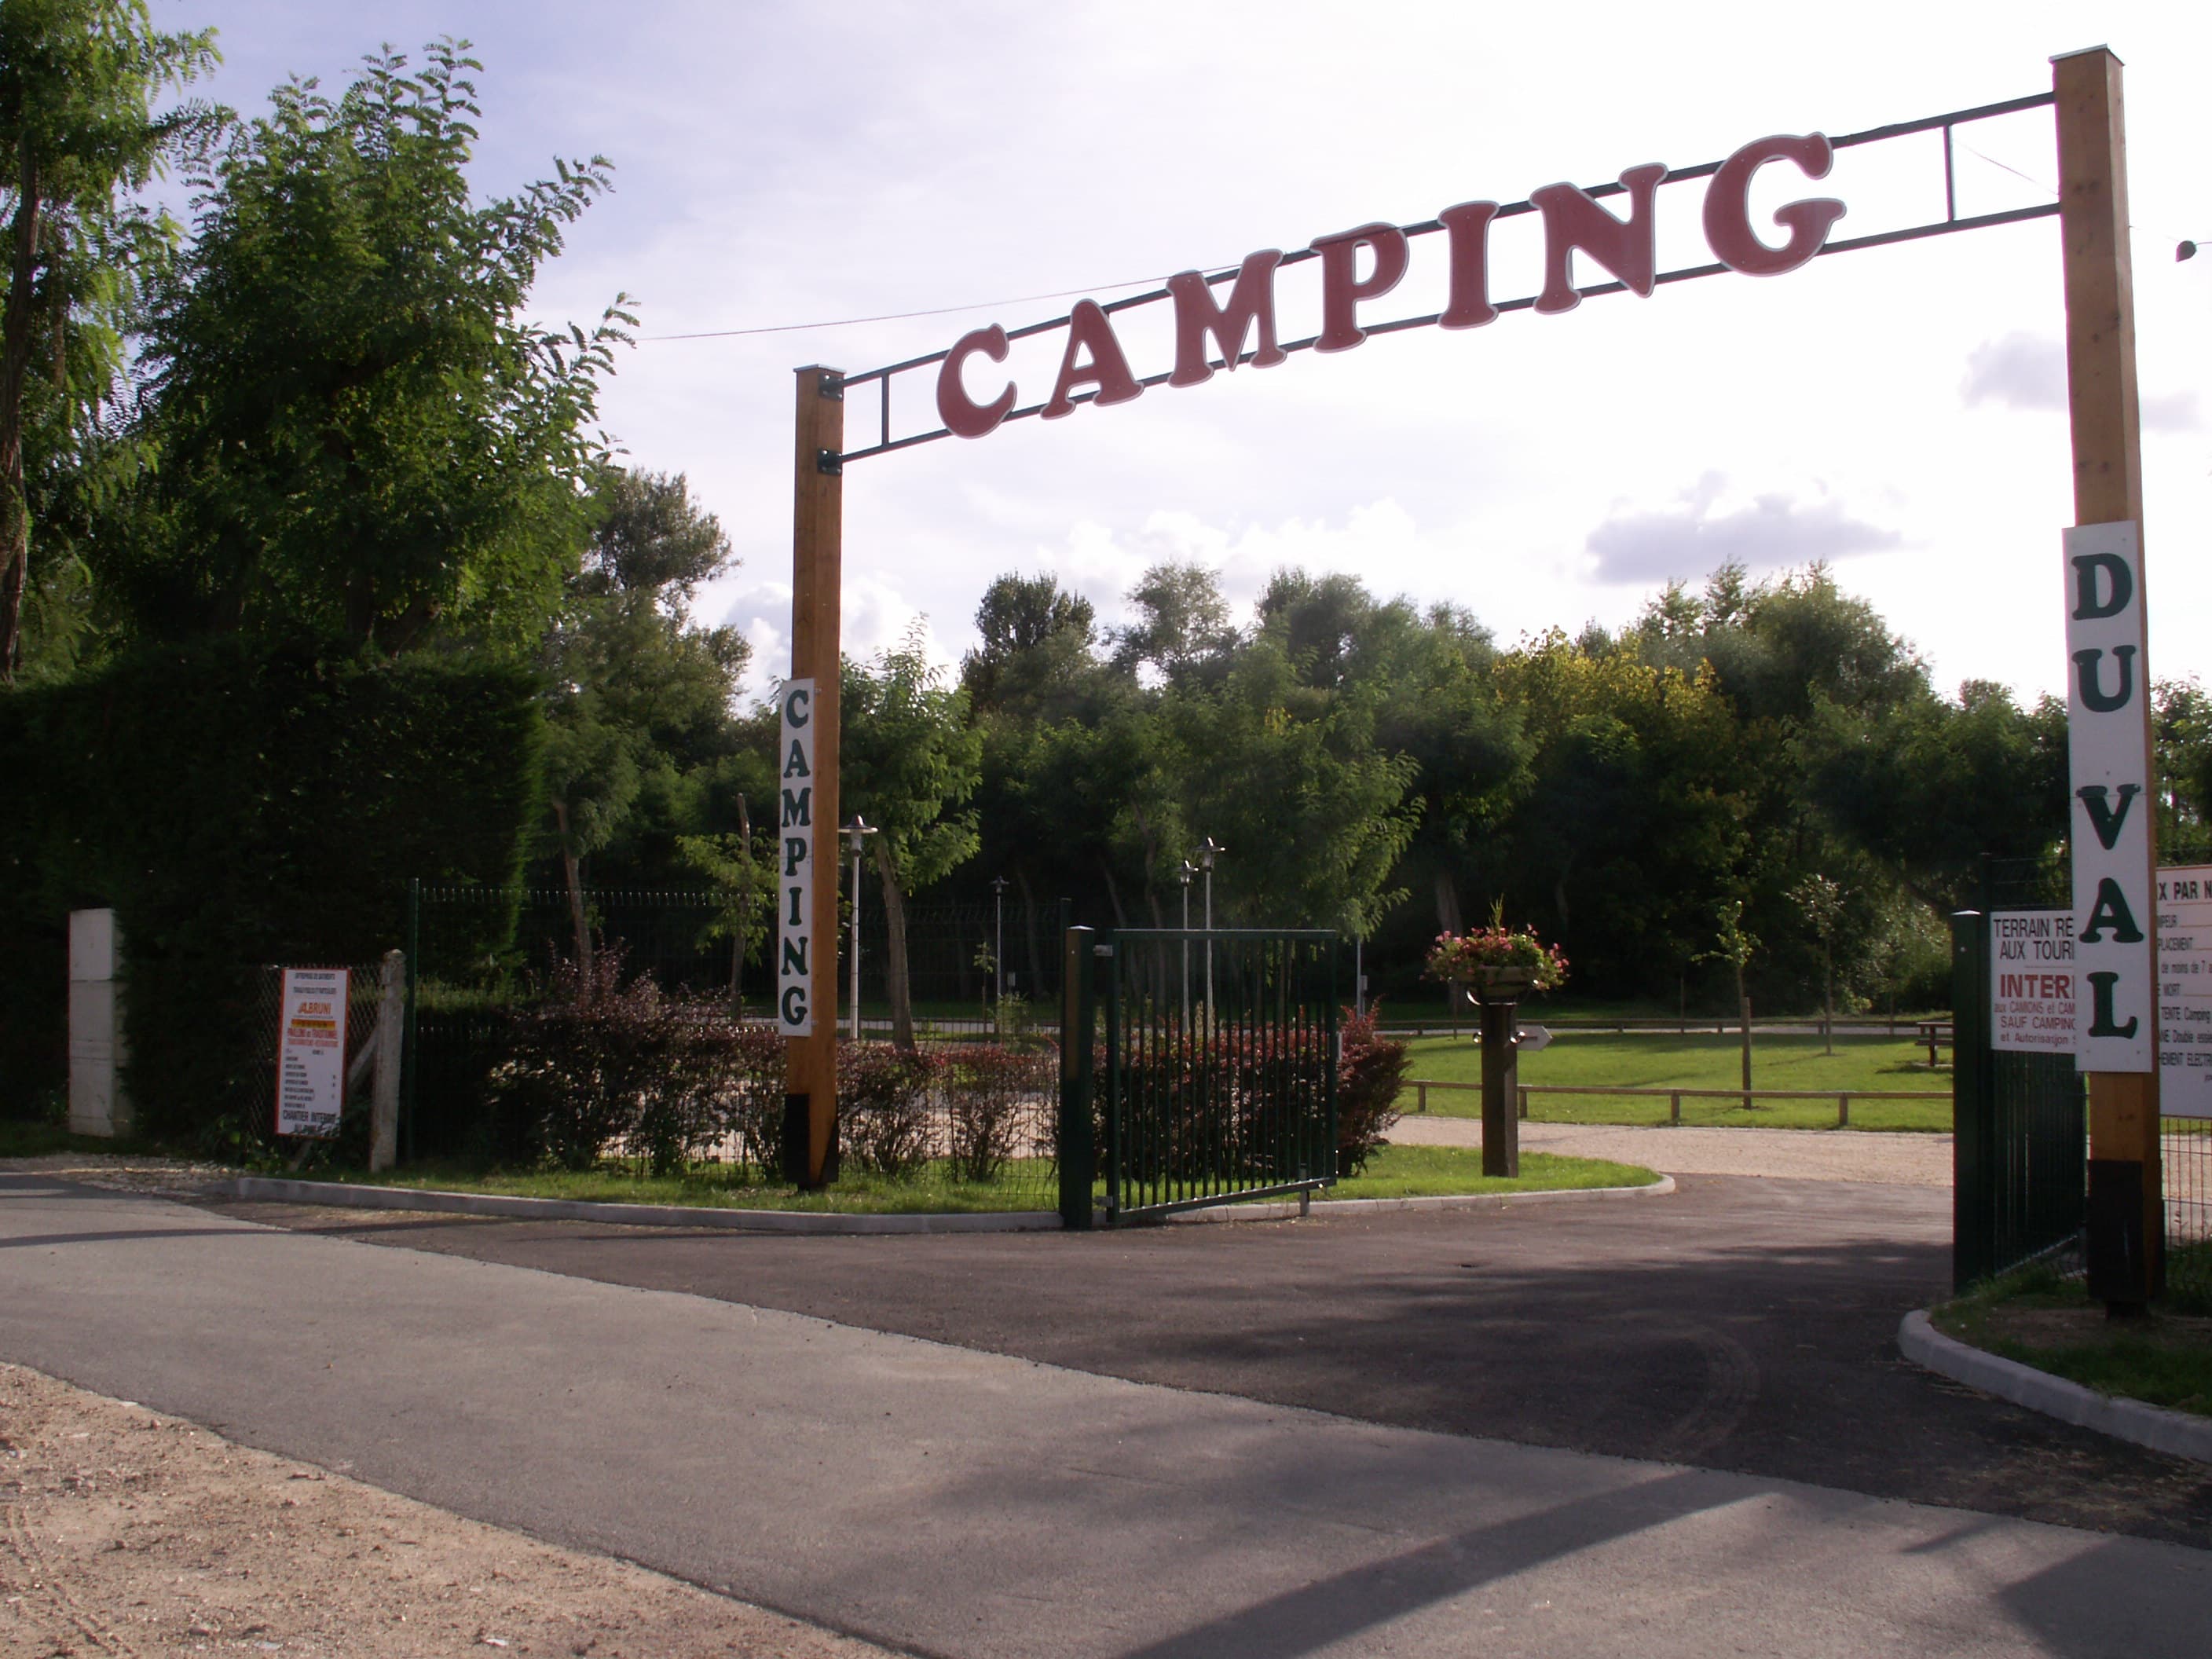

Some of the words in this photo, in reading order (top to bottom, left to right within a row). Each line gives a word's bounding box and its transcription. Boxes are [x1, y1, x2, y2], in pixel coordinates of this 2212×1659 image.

[936, 130, 1847, 440] CAMPING
[781, 689, 811, 1025] CAMPING
[2174, 881, 2198, 899] PAR
[1993, 918, 2049, 937] TERRAIN
[1999, 940, 2025, 959] AUX
[2000, 973, 2075, 999] INTER
[2000, 1016, 2027, 1028] SAUF
